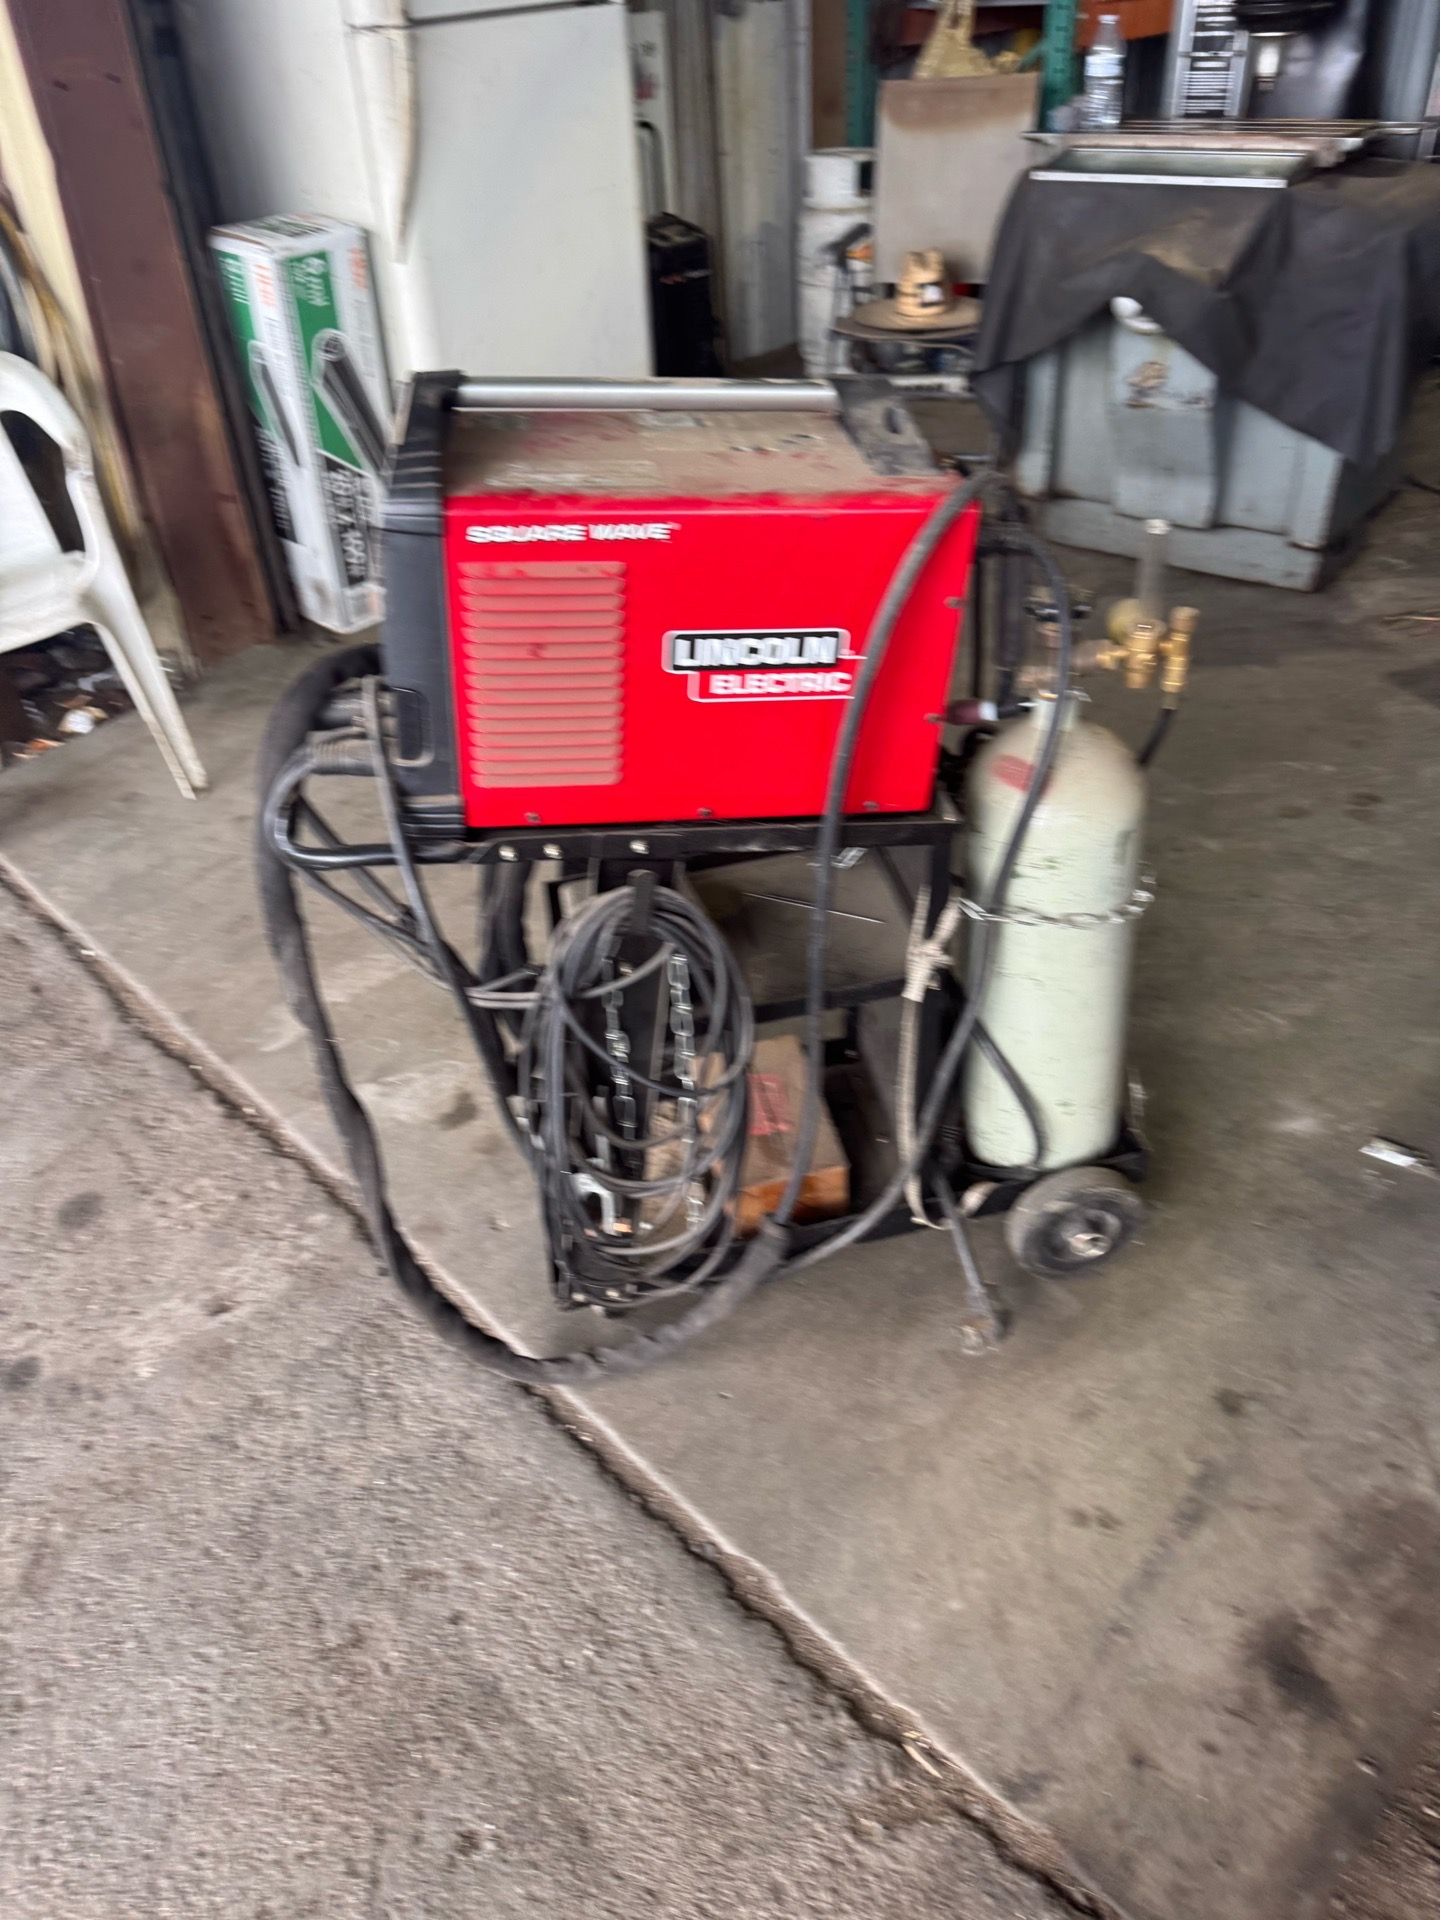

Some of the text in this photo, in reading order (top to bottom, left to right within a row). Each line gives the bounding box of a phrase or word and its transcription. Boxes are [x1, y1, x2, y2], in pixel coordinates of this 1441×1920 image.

[465, 522, 672, 543] SQUARE WAVE
[674, 636, 838, 667] LINCOLN
[708, 671, 853, 695] ELECTRIC
